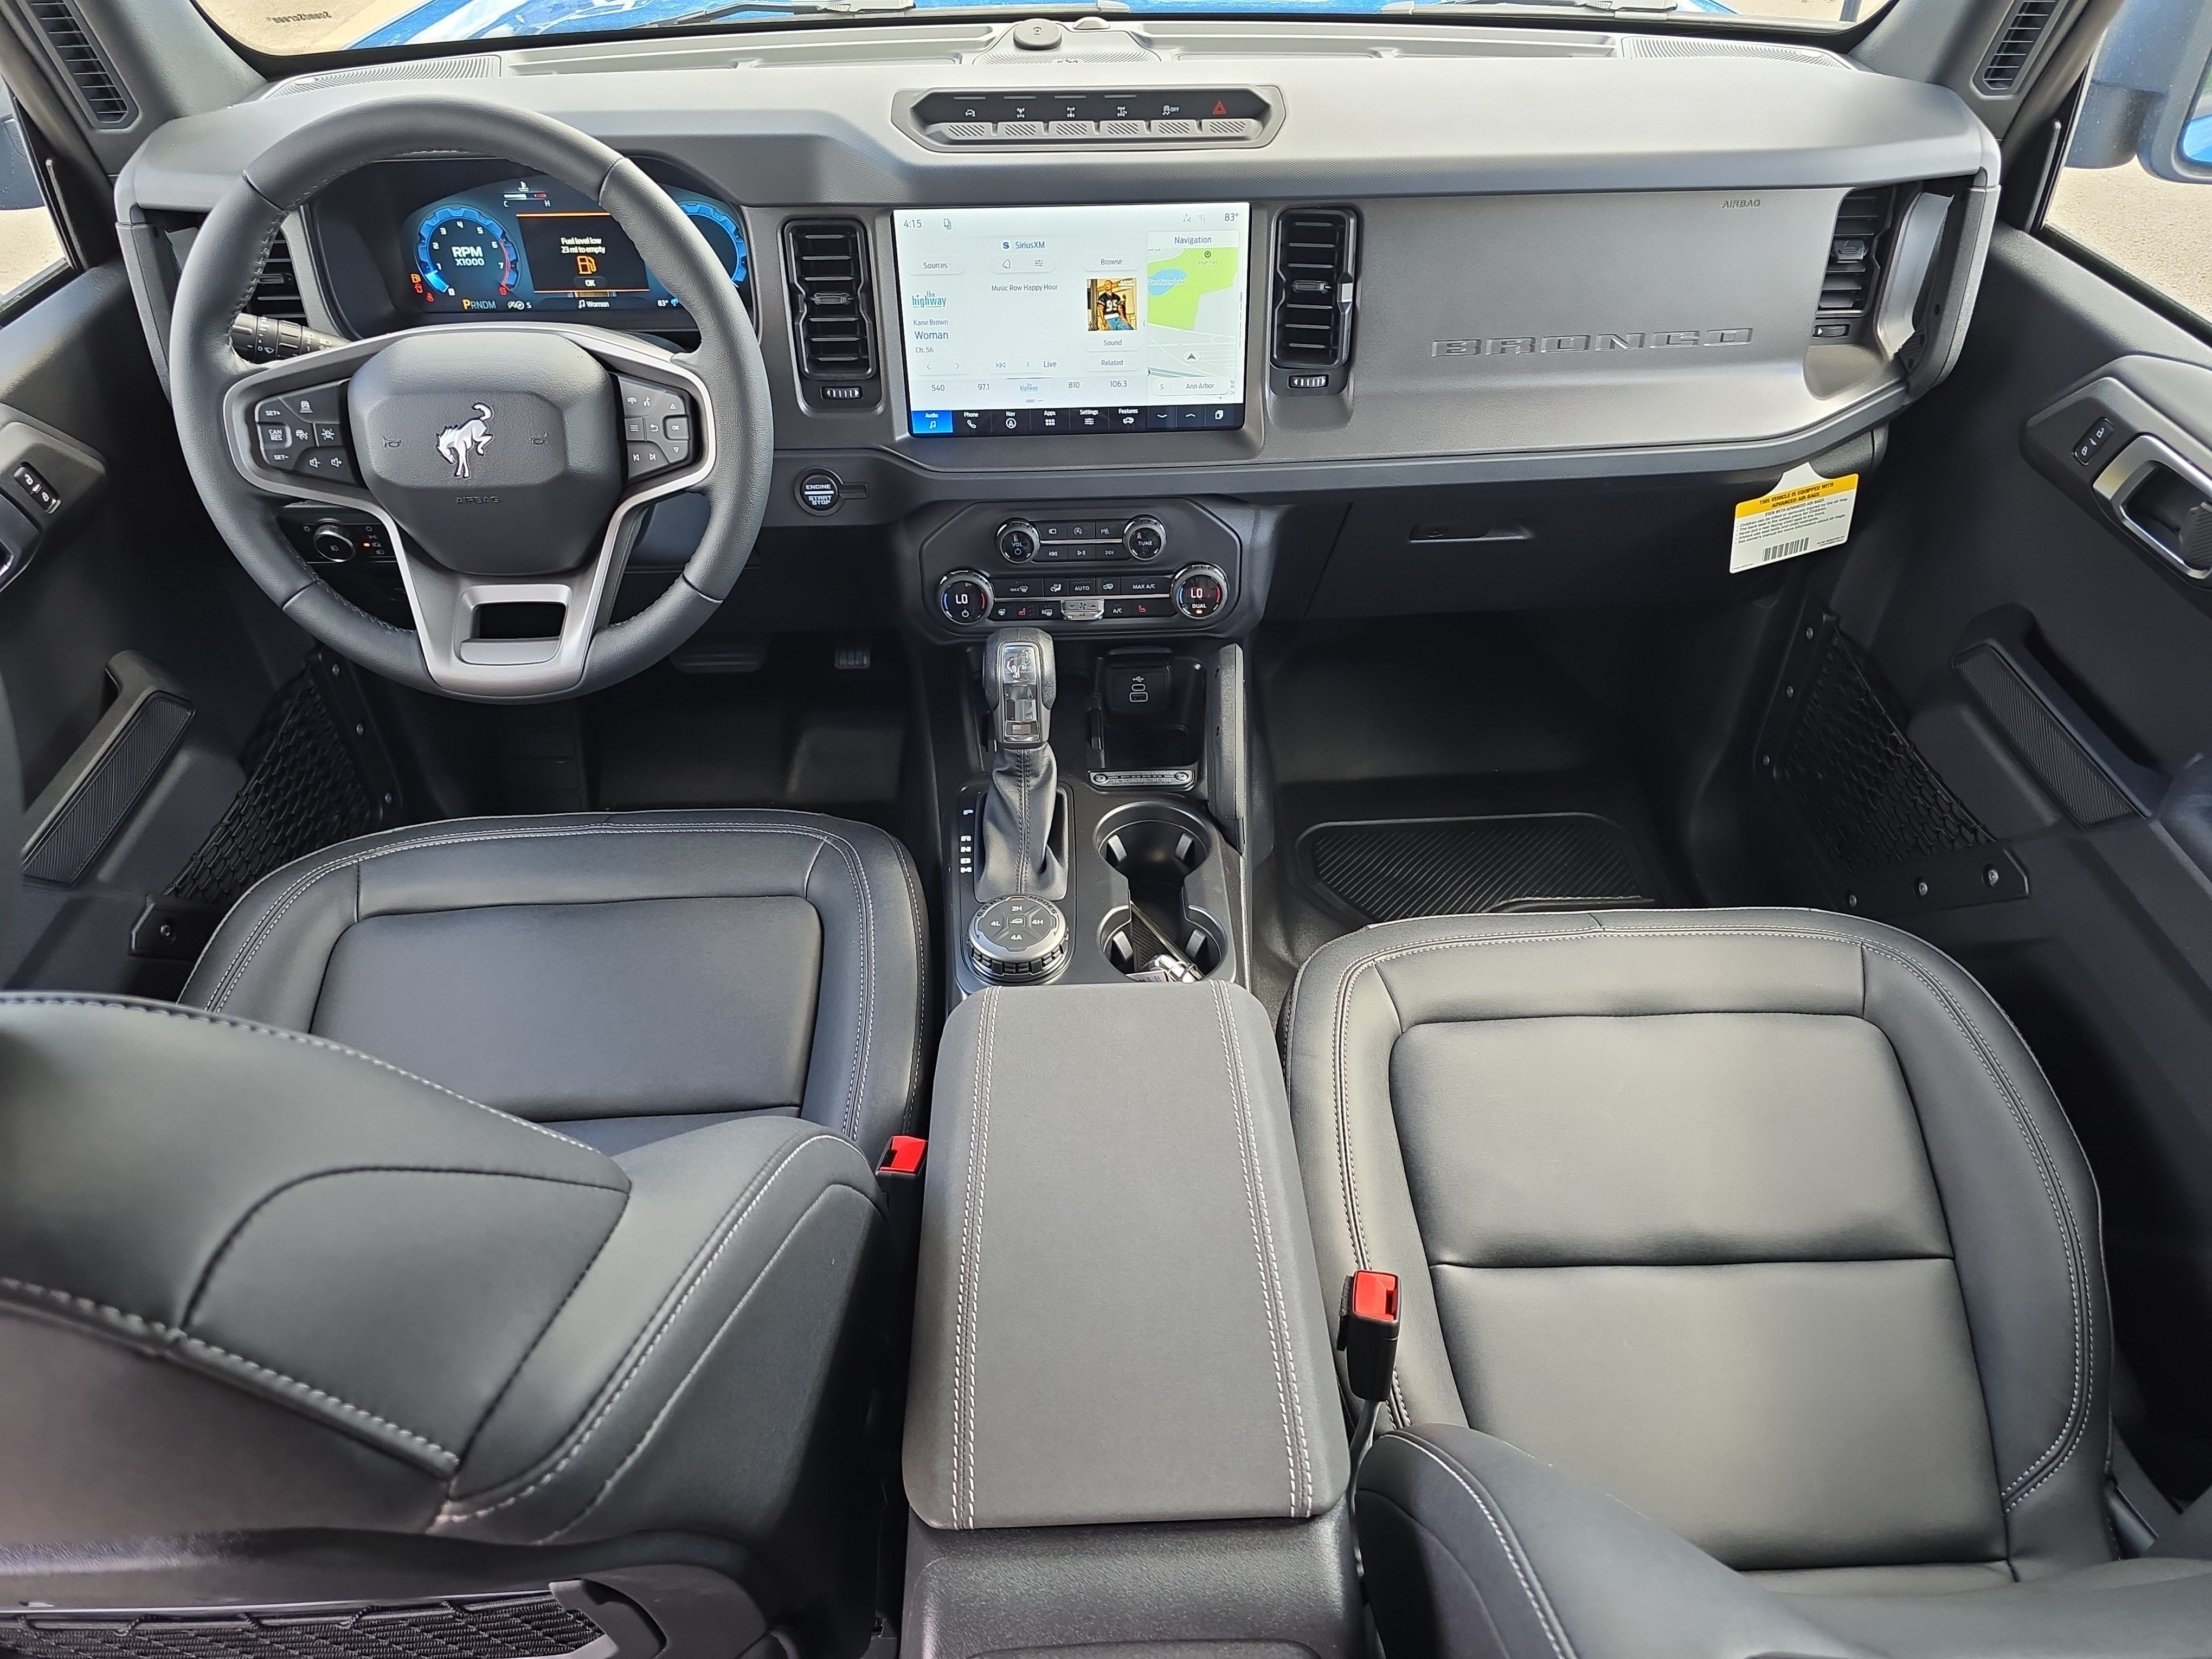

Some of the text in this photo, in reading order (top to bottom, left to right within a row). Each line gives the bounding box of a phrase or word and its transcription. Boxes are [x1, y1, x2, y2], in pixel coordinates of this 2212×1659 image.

[1722, 199, 1761, 208] AIRBAG
[1224, 213, 1239, 221] 83°
[904, 219, 922, 228] 4:15
[1015, 241, 1045, 249] SiriusXM
[1174, 236, 1212, 245] Navigation
[452, 247, 483, 258] RPM
[455, 258, 485, 266] X1000
[912, 295, 946, 307] highway
[915, 331, 948, 340] Woman
[1431, 327, 1753, 357] BRONCO
[1771, 493, 1790, 501] VEHICLE
[1797, 486, 1820, 495] EQUIPPED
[456, 496, 500, 504] AIRBAG
[1771, 498, 1797, 508] ADVANCED
[1786, 503, 1806, 511] ADVANCED
[1795, 521, 1817, 529] information
[1191, 588, 1203, 599] LO
[955, 594, 968, 604] LO
[1029, 896, 1057, 914] MODES
